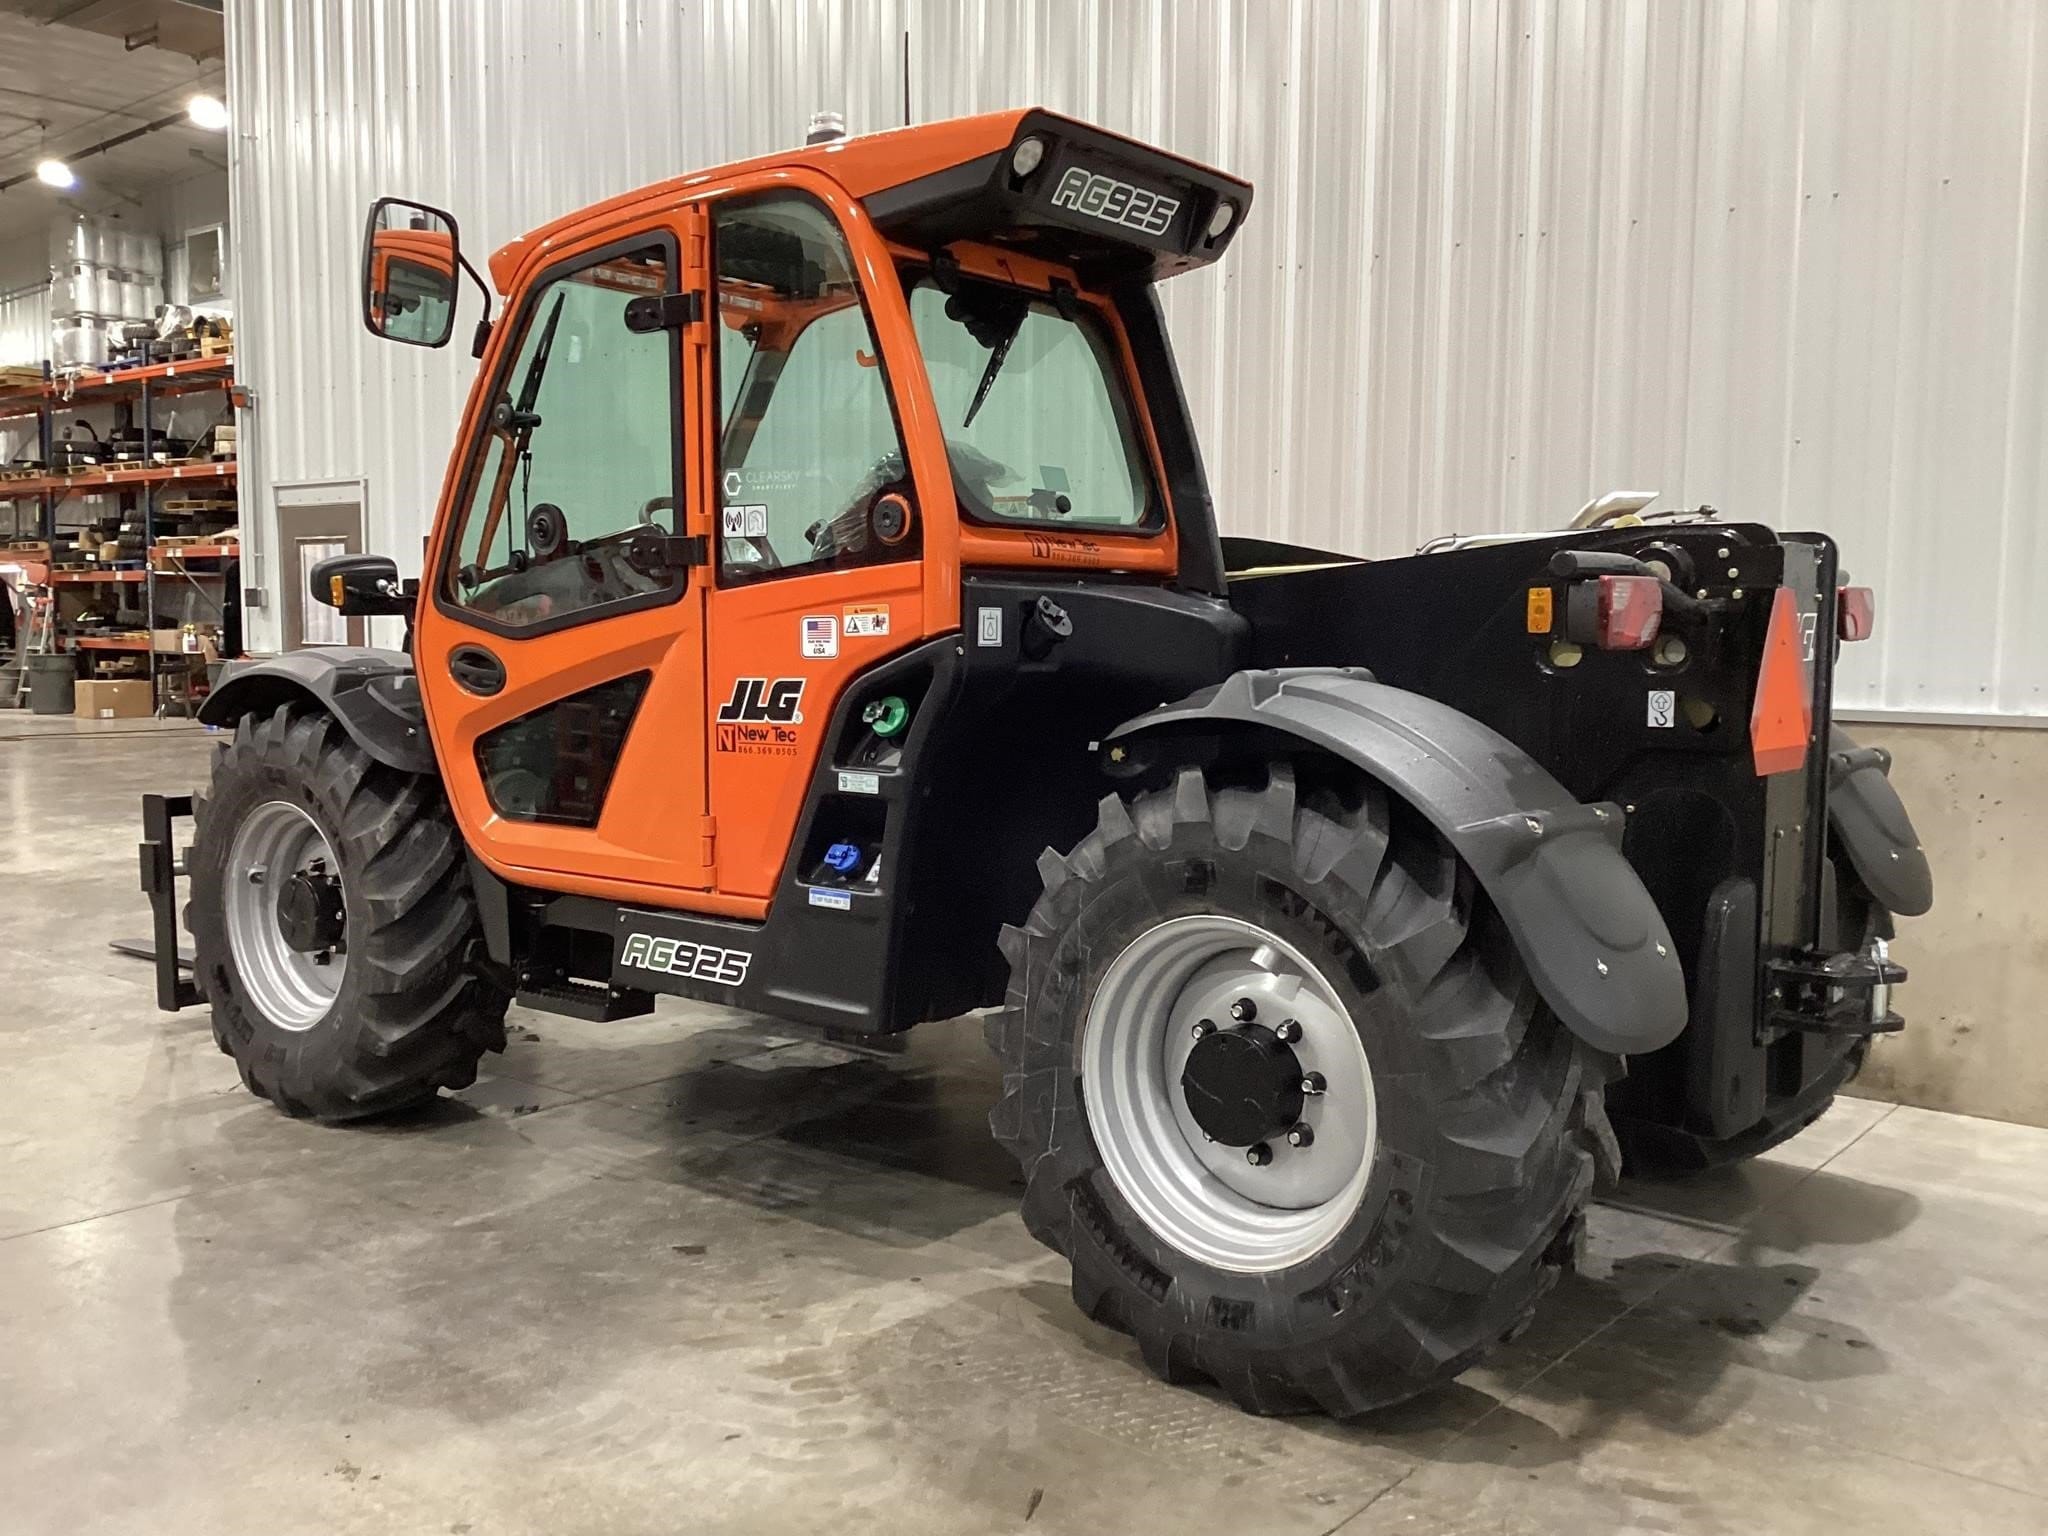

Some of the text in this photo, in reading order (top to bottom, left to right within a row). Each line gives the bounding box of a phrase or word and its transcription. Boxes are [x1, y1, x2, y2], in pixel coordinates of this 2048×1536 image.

[1051, 166, 1180, 236] AG925
[716, 677, 807, 724] JLG
[737, 725, 797, 742] New Tec
[620, 932, 753, 987] AG925
